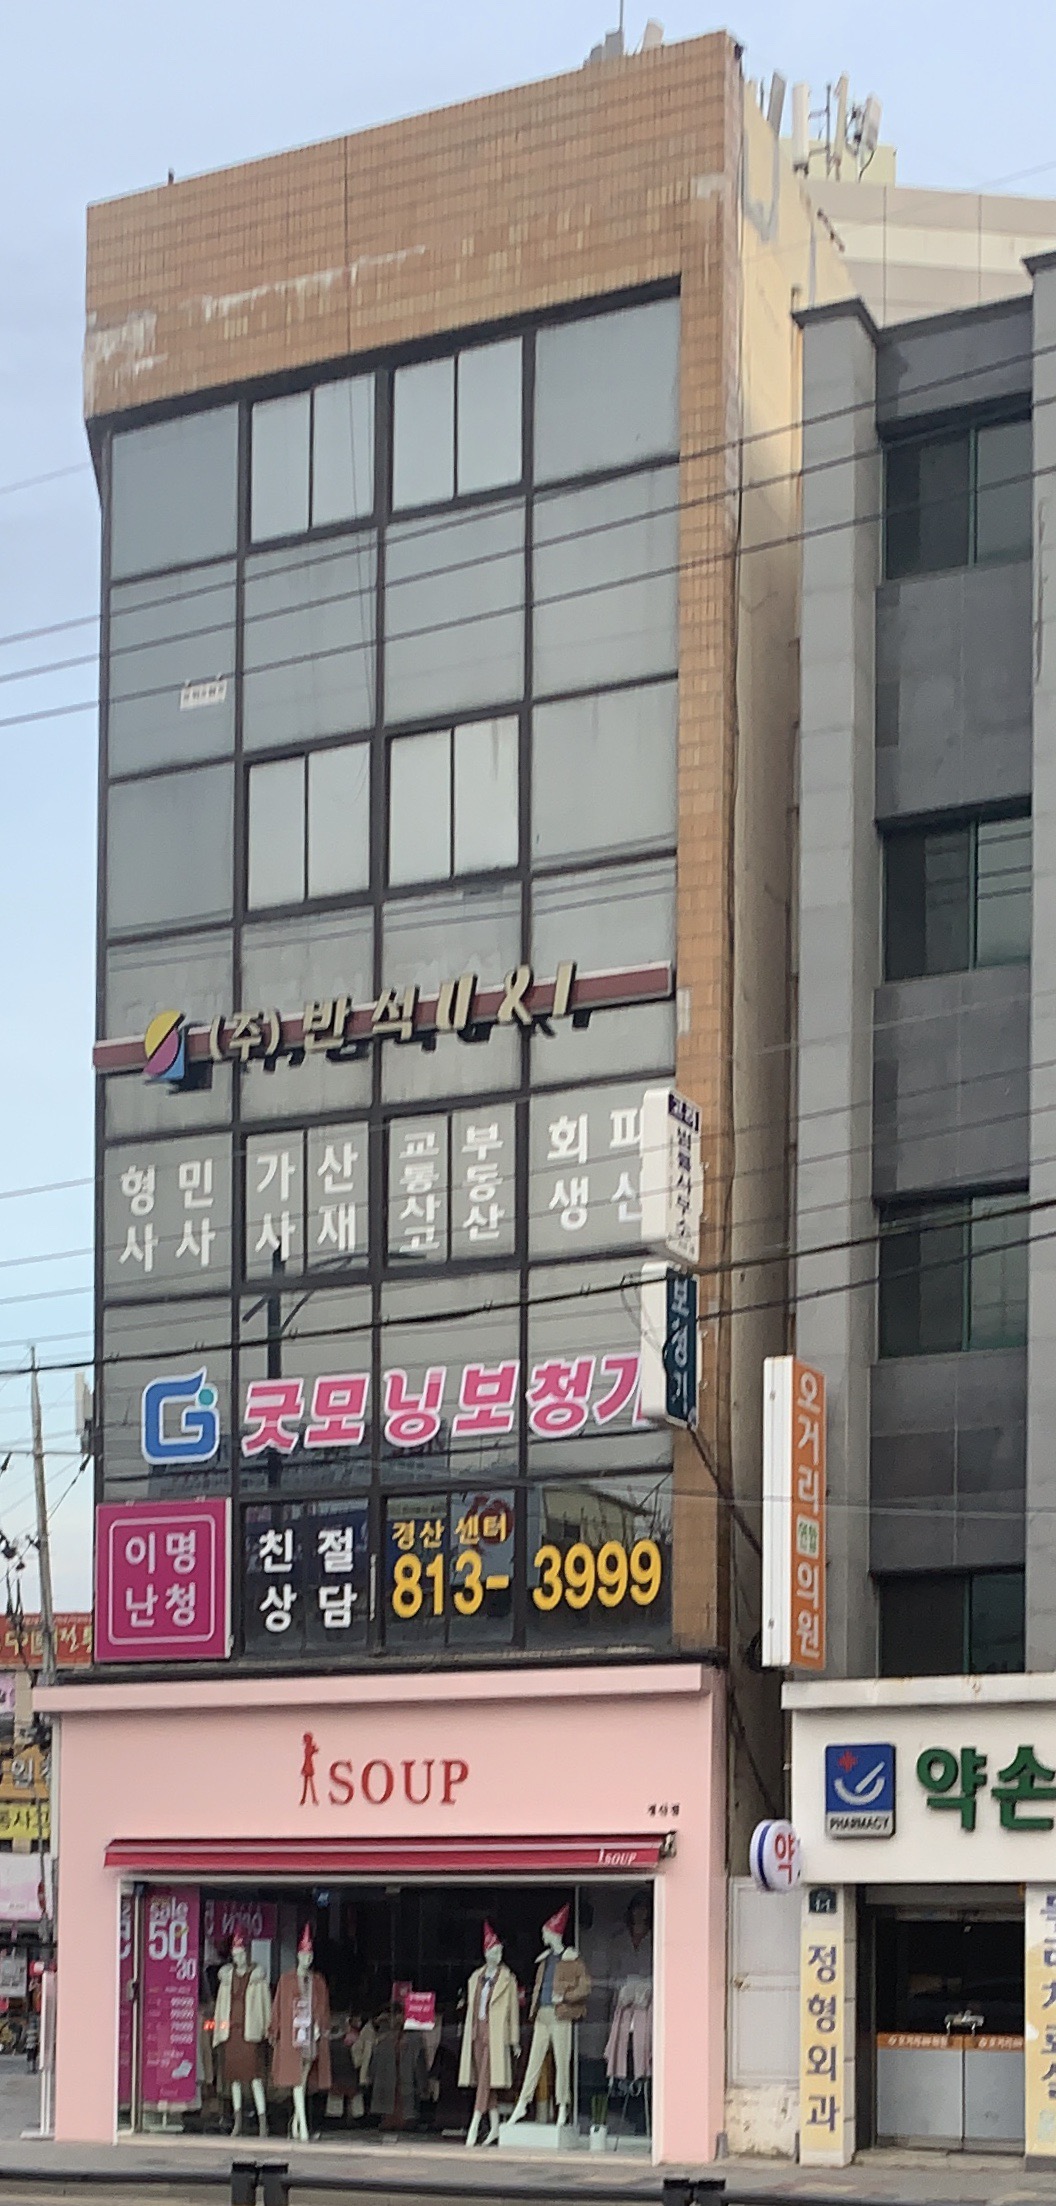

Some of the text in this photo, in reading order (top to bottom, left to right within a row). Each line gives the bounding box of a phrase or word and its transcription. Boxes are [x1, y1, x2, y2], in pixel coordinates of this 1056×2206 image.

[209, 1009, 281, 1063] (주)
[303, 984, 420, 1053] 반석
[118, 1164, 159, 1273] 형사
[175, 1158, 216, 1267] 민사
[255, 1151, 296, 1261] 가사
[317, 1142, 358, 1253] 산재
[399, 1131, 441, 1253] 교통사고
[461, 1122, 505, 1242] 부동산
[547, 1113, 590, 1231] 회생
[241, 1352, 644, 1457] 굿모닝보청기
[797, 1372, 821, 1515] 오거리
[125, 1530, 196, 1574] 이명
[392, 1510, 507, 1550] 경산 센터
[532, 1538, 662, 1611] 3999
[125, 1582, 196, 1628] 난청
[796, 1561, 820, 1659] 의원
[829, 1815, 889, 1831] PHARMACY
[805, 1945, 840, 2132] 정형외과
